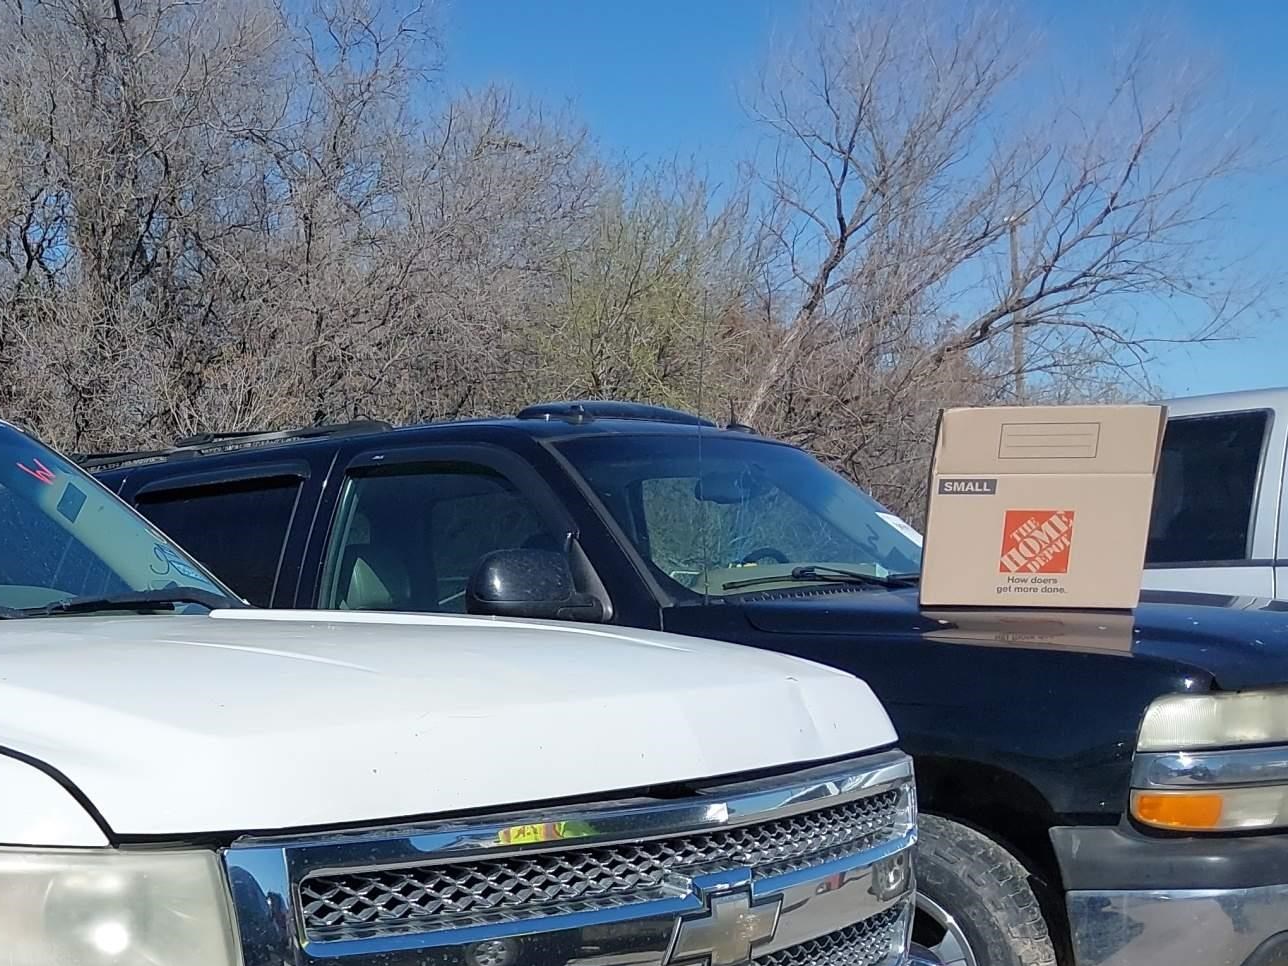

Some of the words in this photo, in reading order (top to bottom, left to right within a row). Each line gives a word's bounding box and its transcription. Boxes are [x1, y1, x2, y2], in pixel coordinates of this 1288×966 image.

[943, 481, 992, 493] SMALL
[1009, 516, 1040, 543] THE
[1000, 511, 1073, 573] HOME
[1026, 533, 1071, 573] DEPOT
[996, 585, 1012, 594] get
[1007, 576, 1029, 584] How
[1030, 576, 1058, 584] doers
